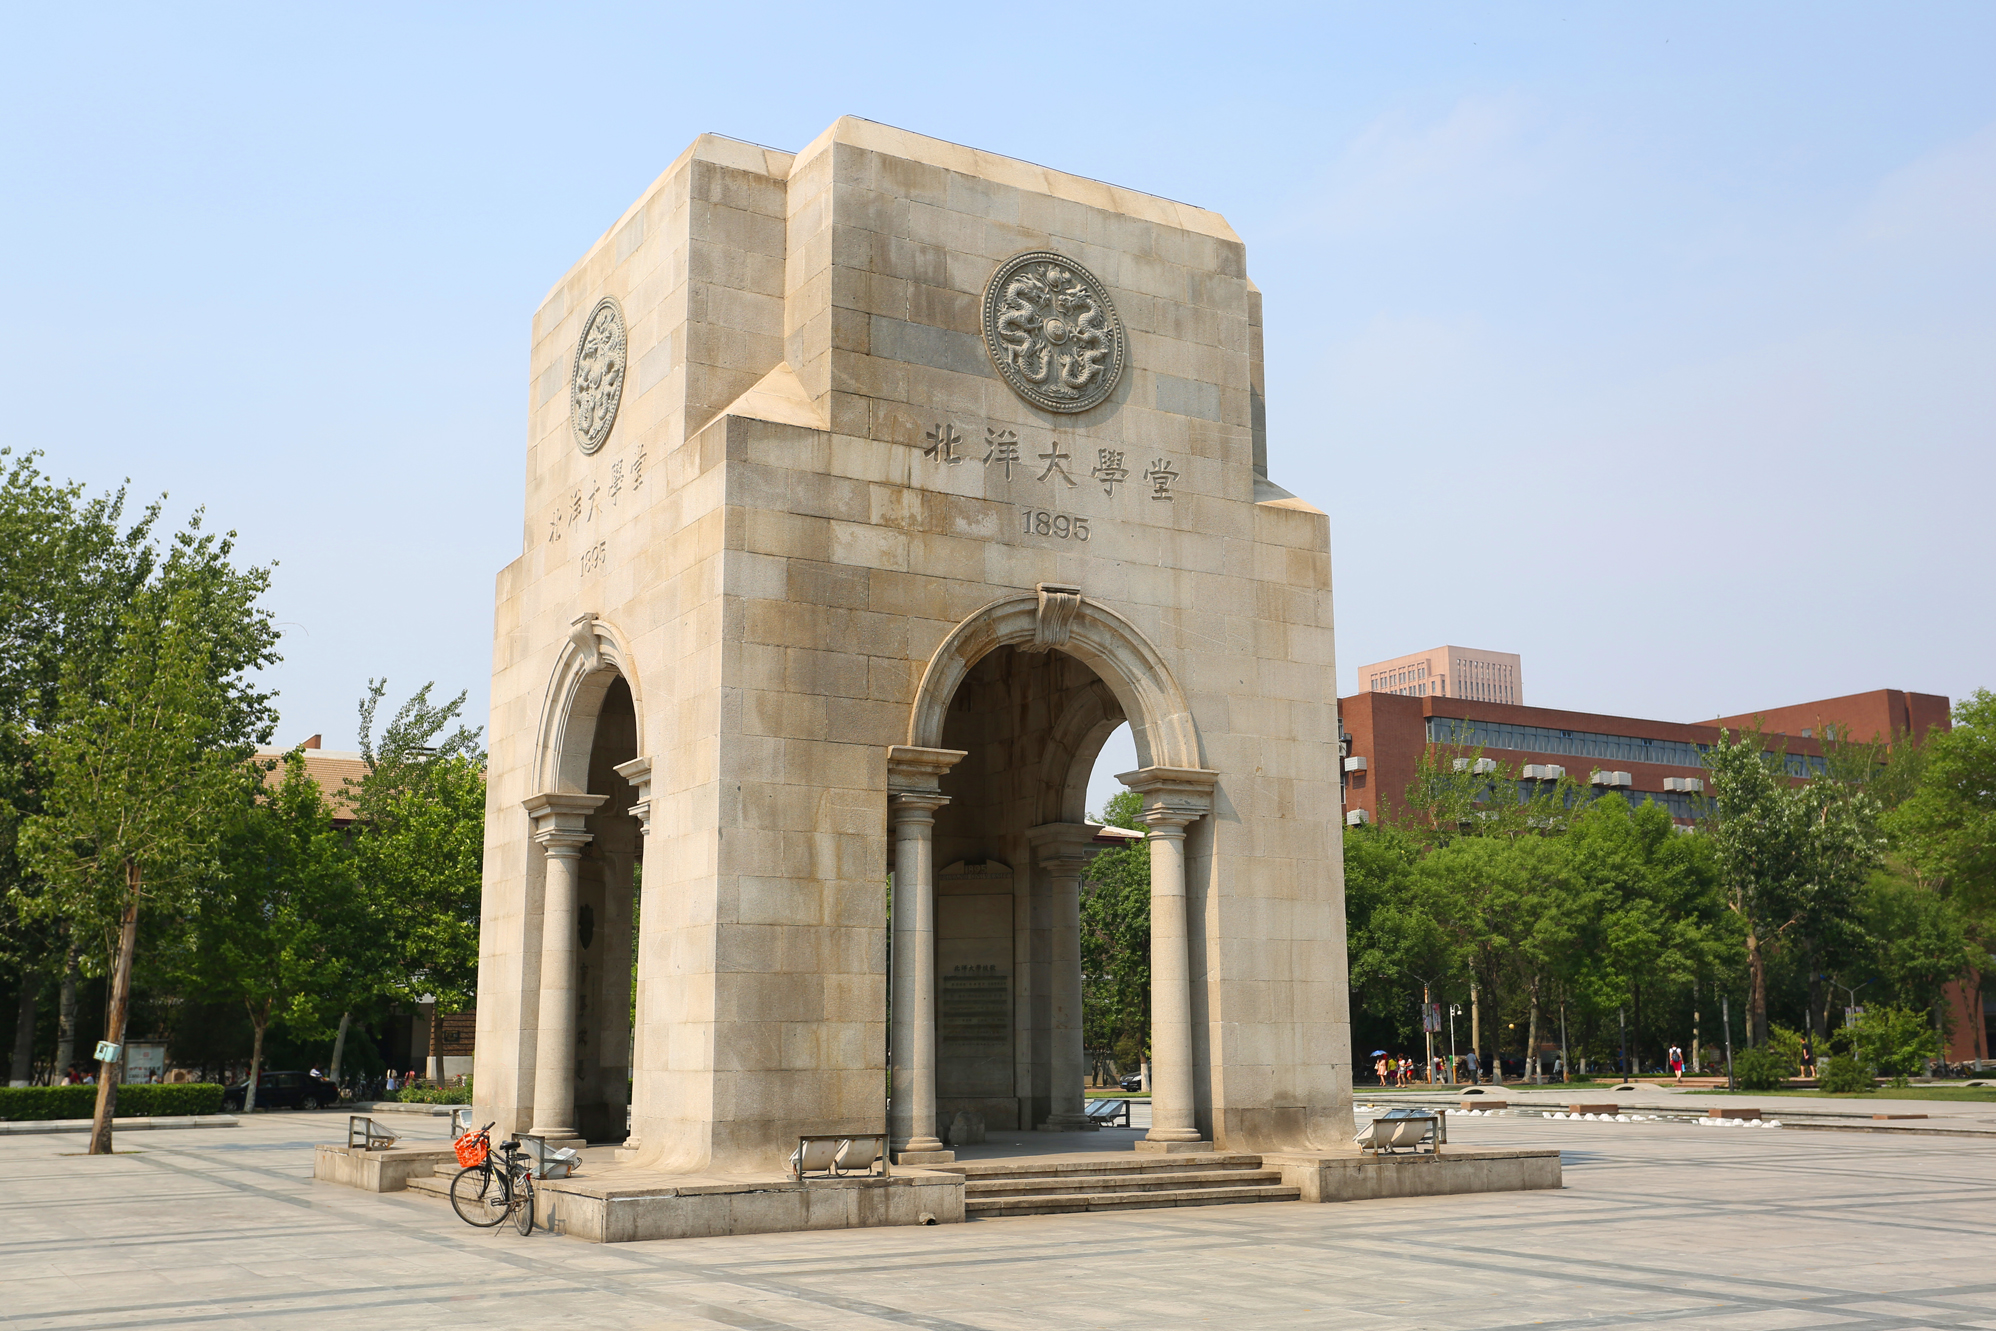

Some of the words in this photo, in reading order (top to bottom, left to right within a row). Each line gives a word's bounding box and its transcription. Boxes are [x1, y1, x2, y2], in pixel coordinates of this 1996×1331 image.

[923, 422, 1180, 503] 北洋大學堂
[548, 443, 647, 545] 北洋大學堂
[1022, 510, 1092, 542] 1895
[580, 540, 606, 577] 1895
[965, 864, 987, 874] 1895
